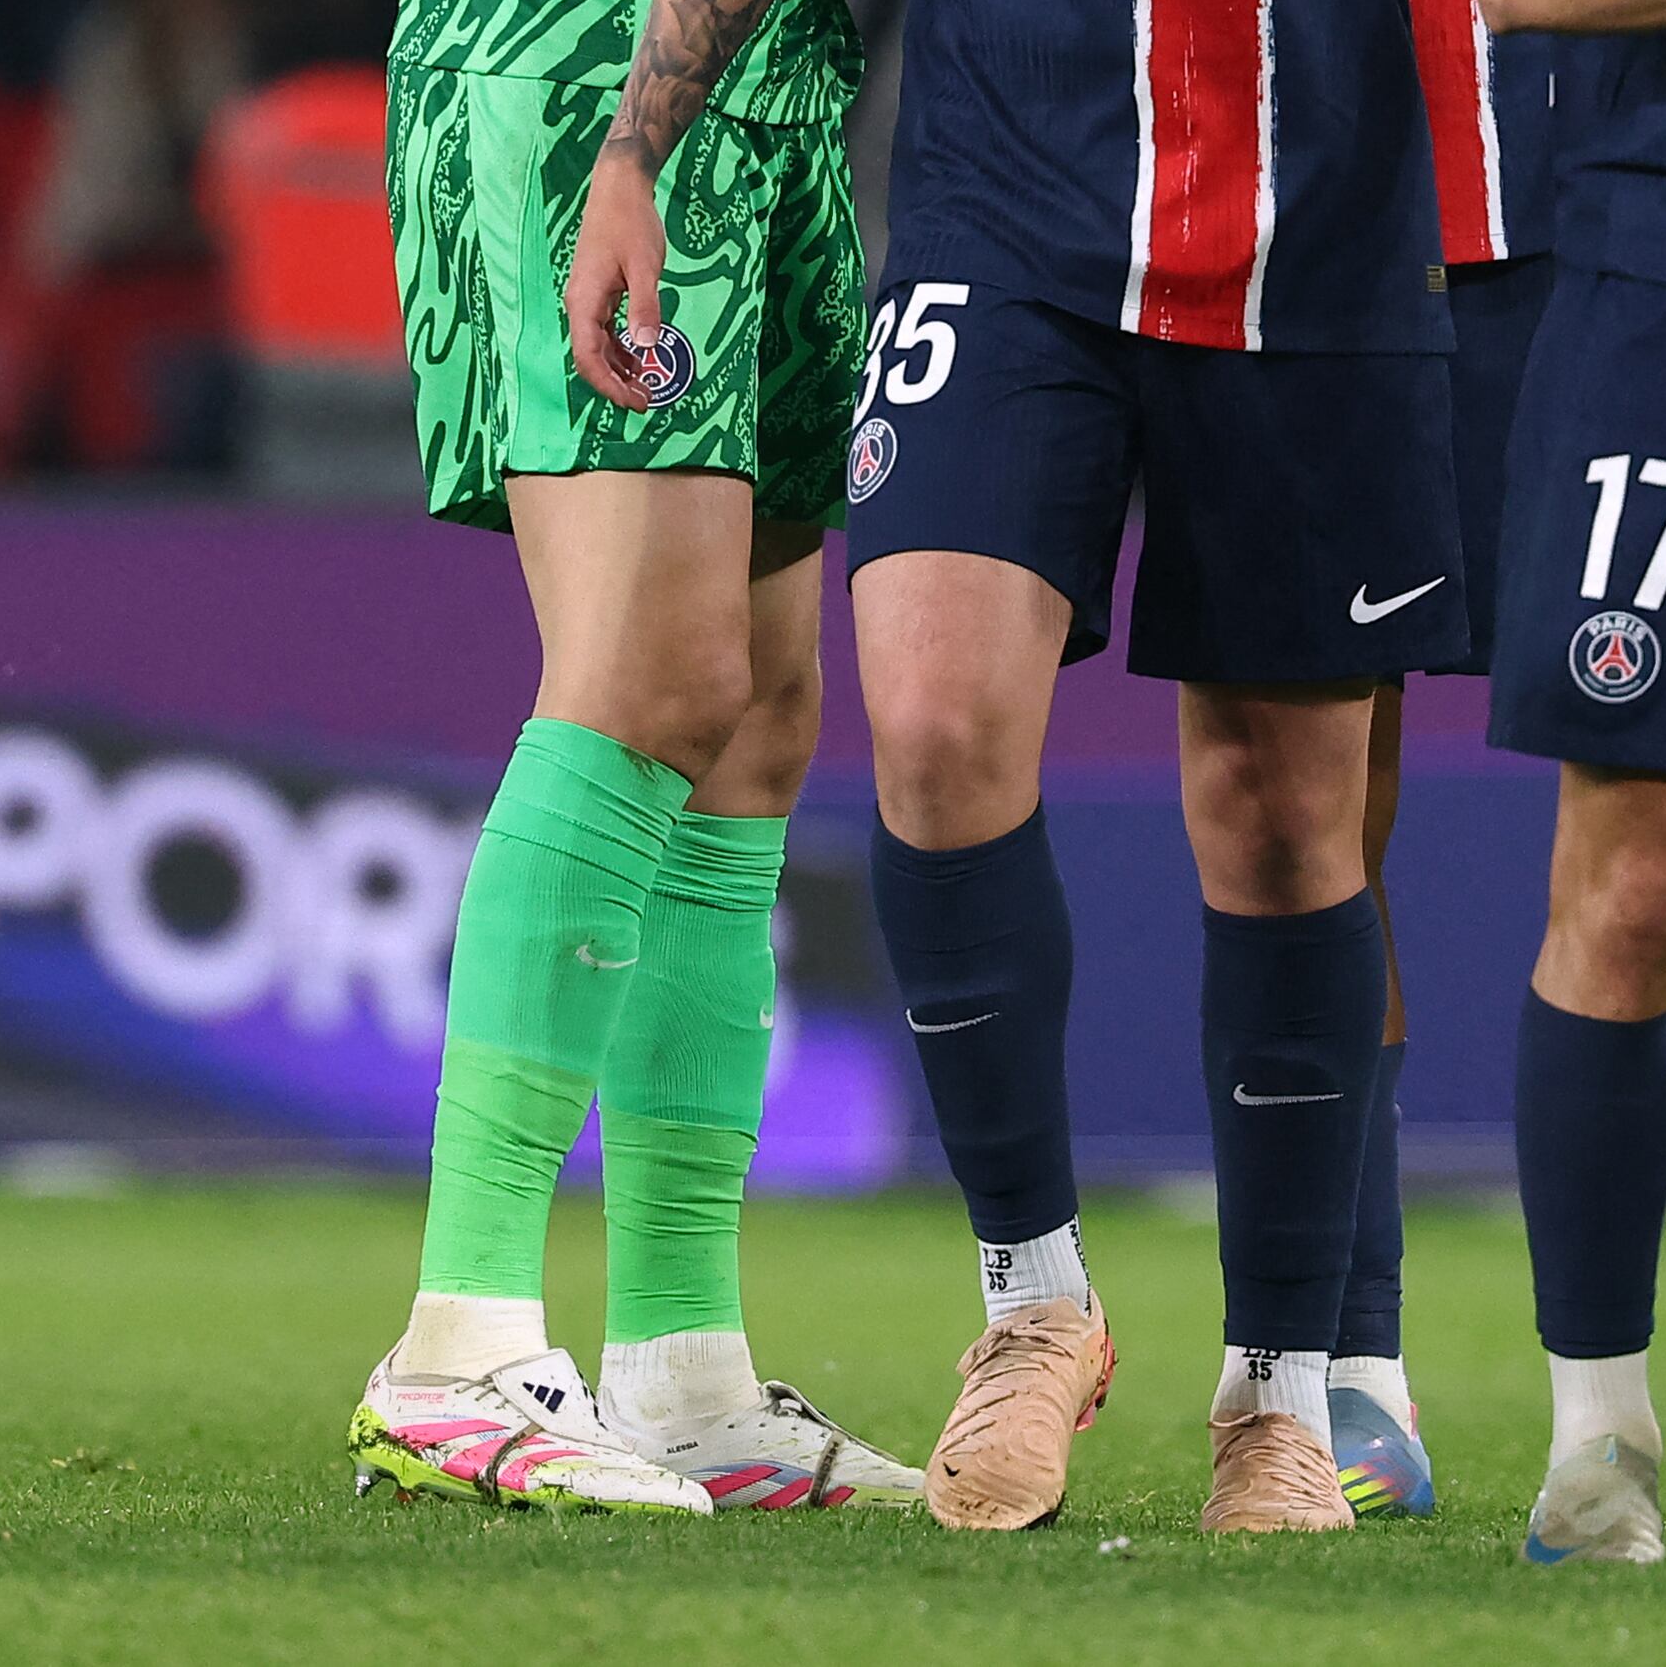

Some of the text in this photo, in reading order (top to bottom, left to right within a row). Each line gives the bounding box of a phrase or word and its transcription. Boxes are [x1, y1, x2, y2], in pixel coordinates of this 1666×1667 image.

[852, 282, 971, 430] 35
[1587, 616, 1649, 643] PARIS
[983, 1247, 1013, 1270] LB
[987, 1270, 1008, 1291] 35
[1248, 1359, 1273, 1381] 35
